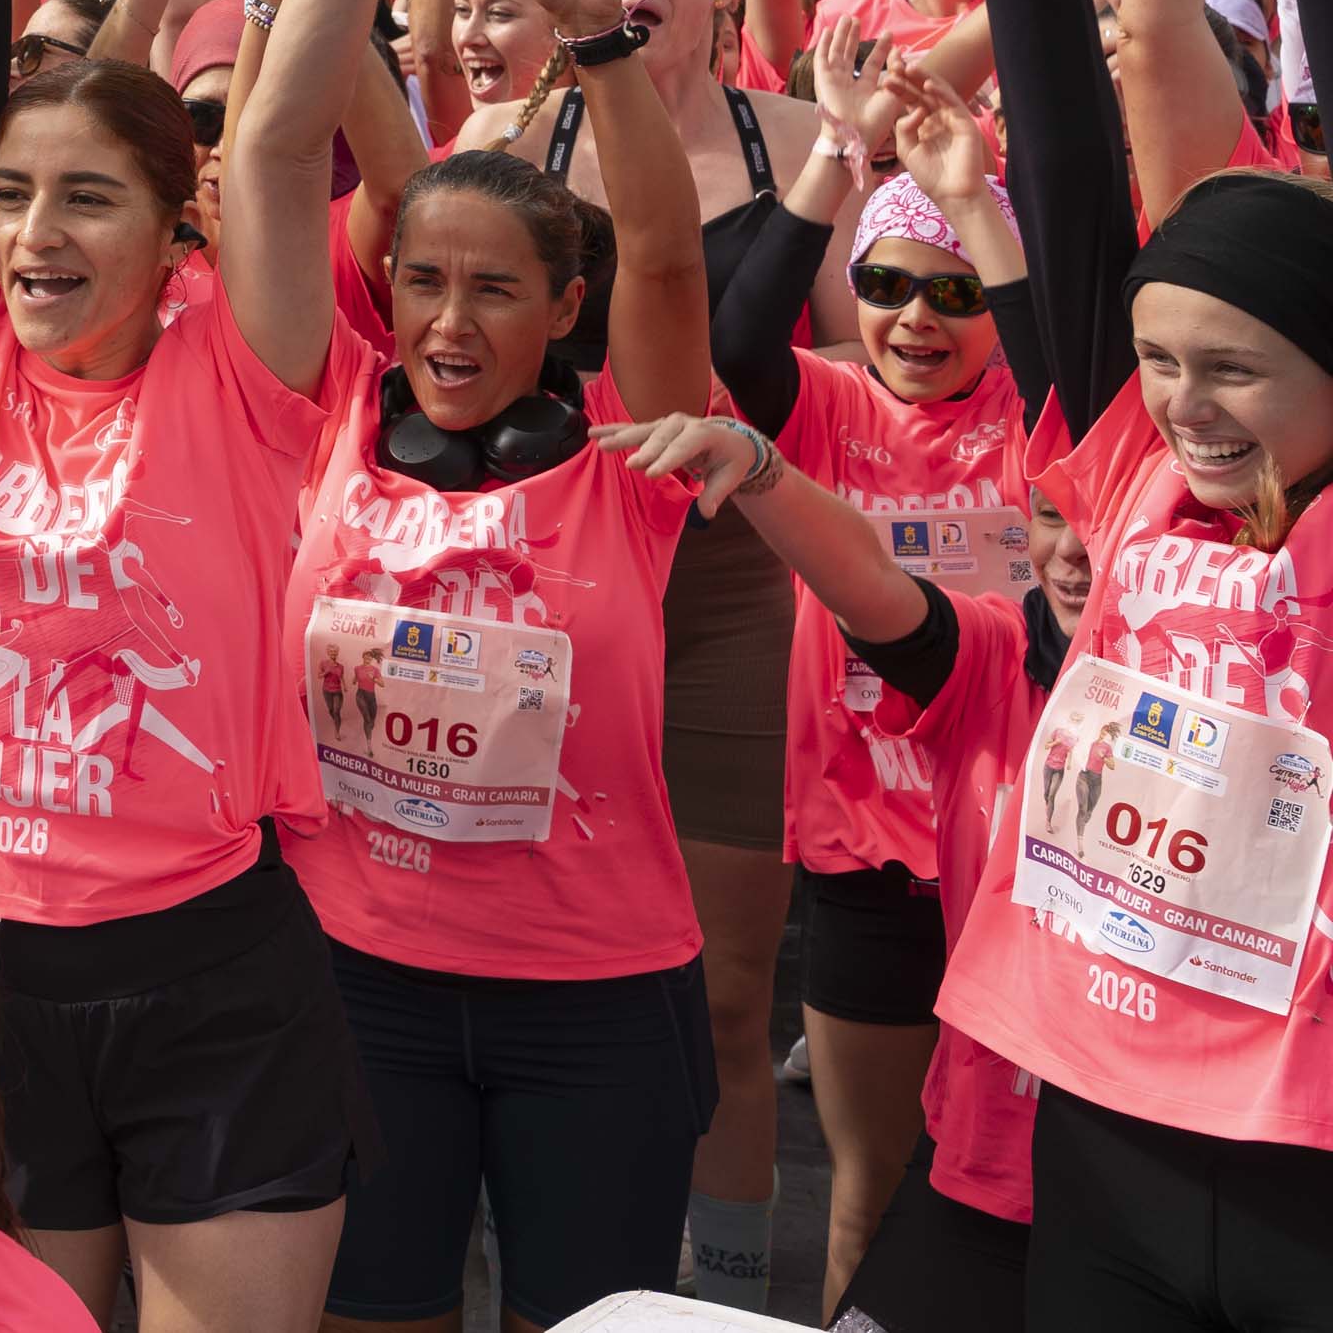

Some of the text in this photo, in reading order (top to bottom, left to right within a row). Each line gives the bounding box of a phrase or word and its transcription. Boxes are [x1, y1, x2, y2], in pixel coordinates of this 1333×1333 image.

[343, 472, 529, 554] CARRERA
[19, 535, 99, 610] DE
[331, 620, 376, 639] SUMA
[10, 657, 73, 746] LA
[1084, 686, 1121, 711] SUMA
[385, 711, 478, 758] 016
[323, 749, 370, 774] CARRERA
[371, 766, 384, 782] DE
[385, 773, 399, 788] LA
[401, 777, 441, 797] MUJER
[452, 787, 486, 802] GRAN
[489, 789, 541, 803] CANARIA
[405, 757, 450, 779] 1630
[1269, 765, 1302, 782] Carrera
[338, 781, 375, 804] OYSHO
[398, 804, 445, 827] ASTURIANA
[485, 817, 525, 828] Santander
[366, 830, 432, 874] 2026
[1106, 801, 1209, 874] 016
[1032, 843, 1079, 880] CARRERA
[1079, 871, 1093, 888] DE
[1096, 877, 1115, 896] LA
[1164, 907, 1208, 934] GRAN
[1211, 924, 1282, 959] CANARIA
[1047, 884, 1083, 915] OYSHO
[1203, 959, 1258, 986] Santander
[1085, 963, 1157, 1023] 2026
[696, 1253, 769, 1279] MAGIC
[701, 1243, 764, 1264] STAY
